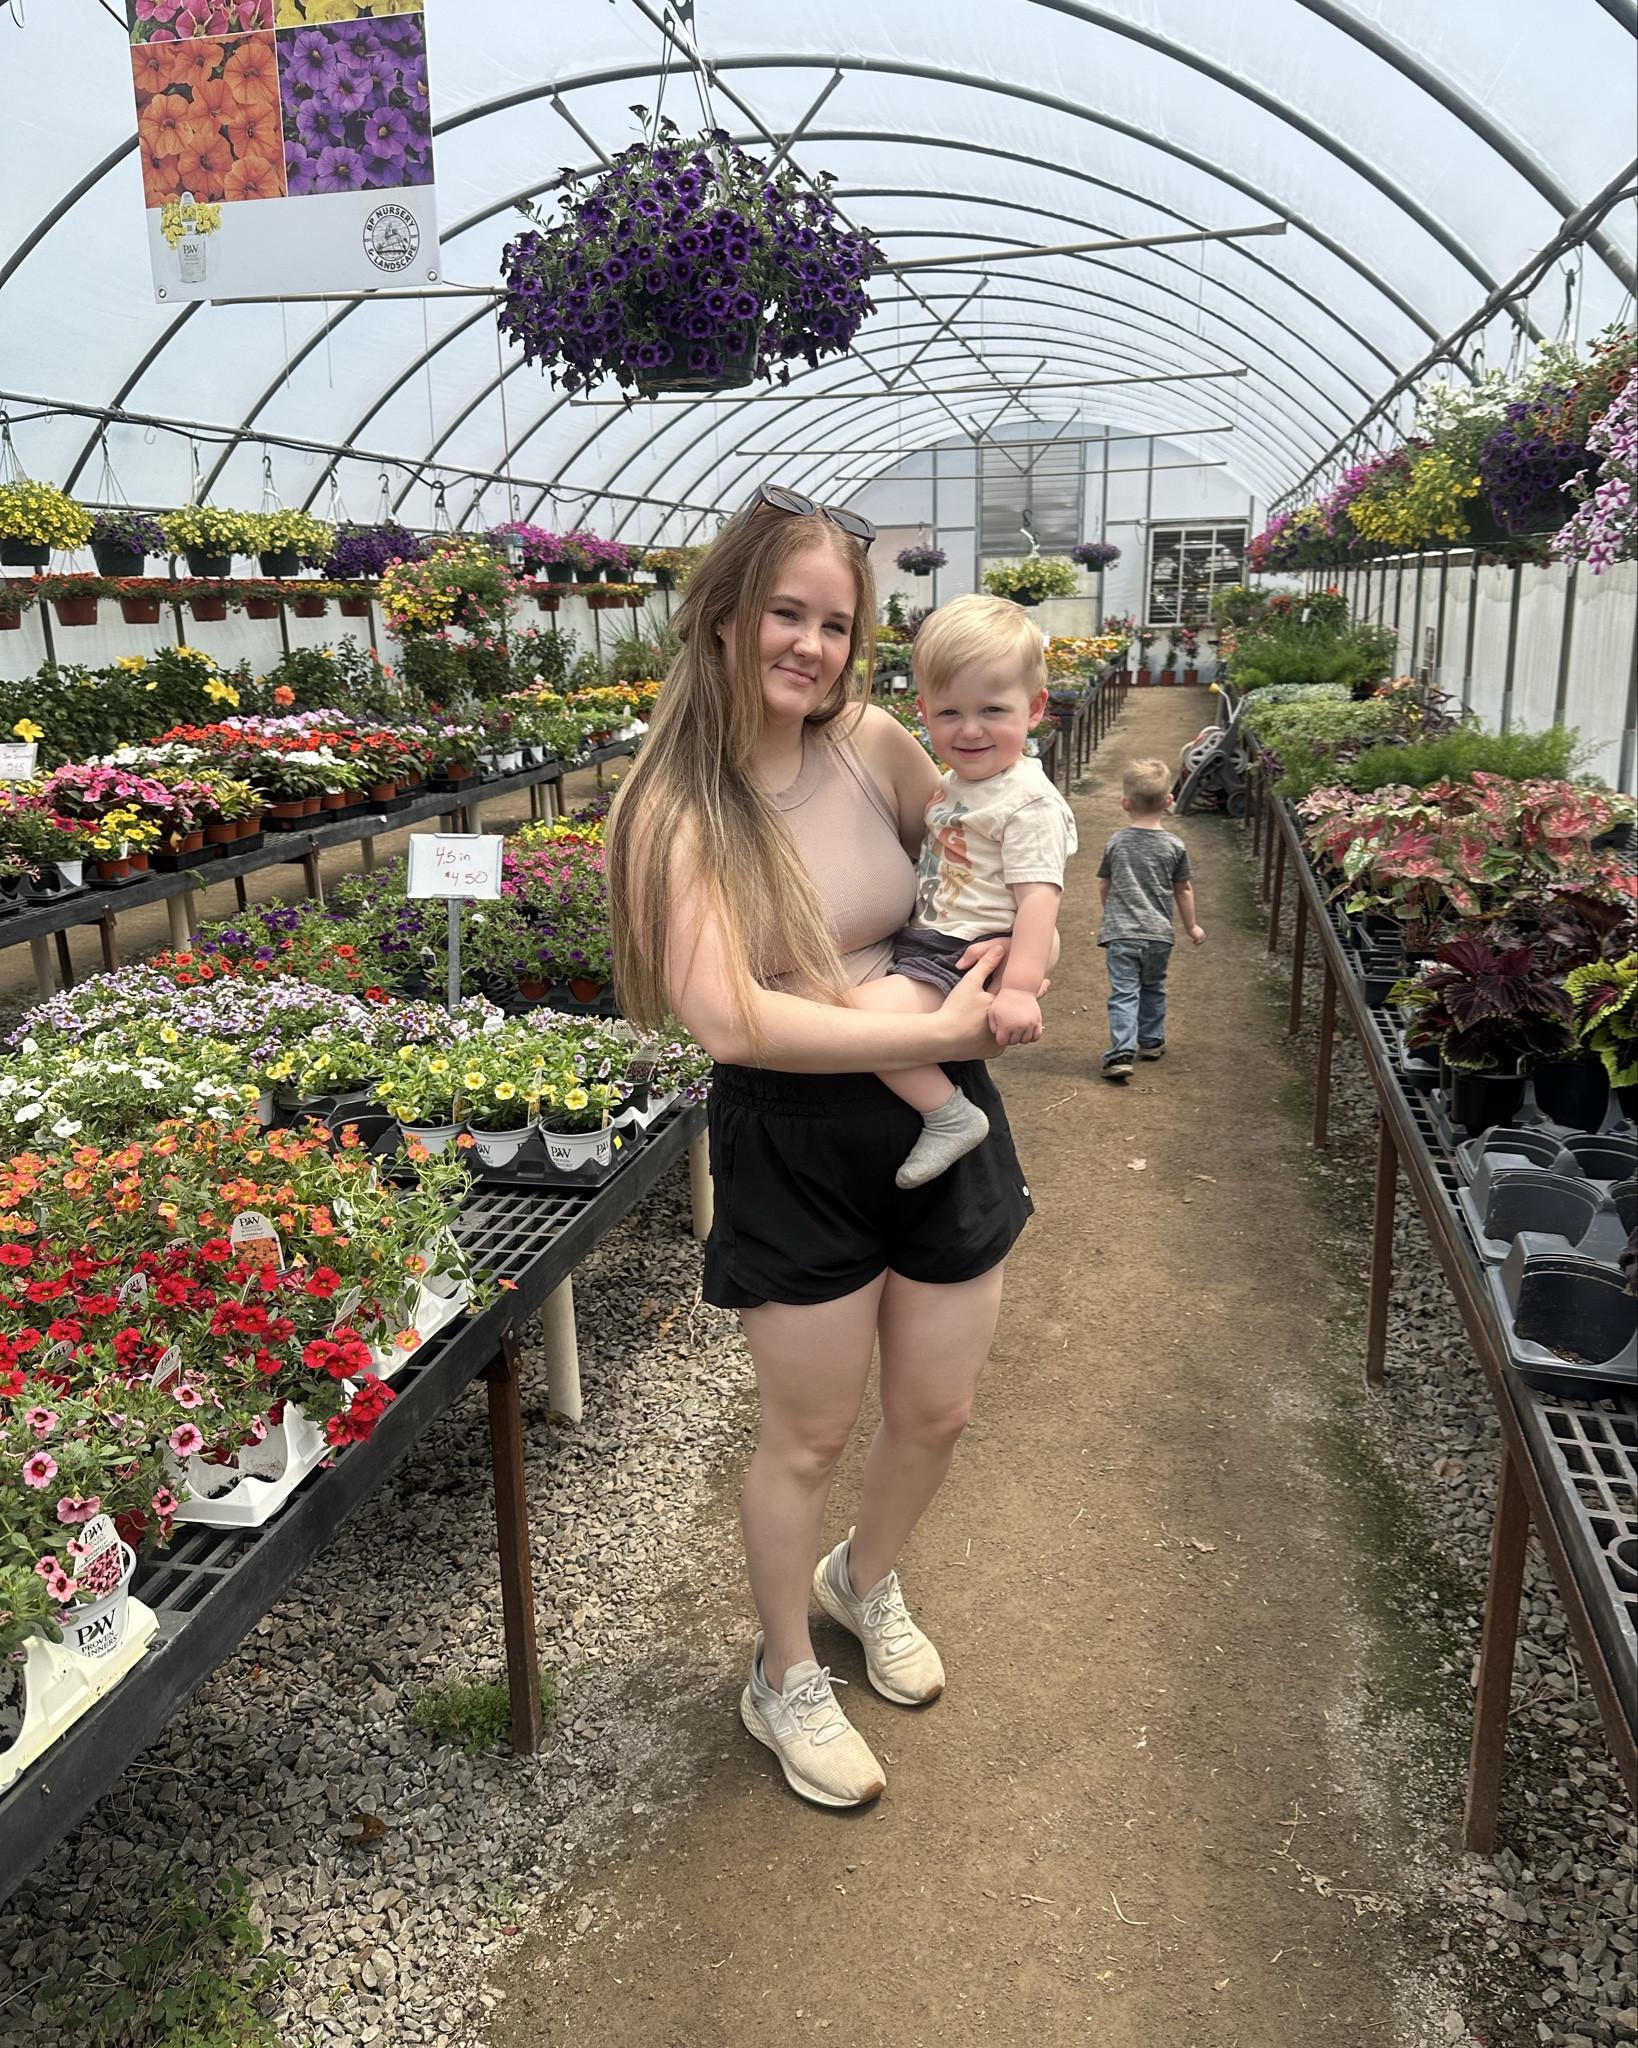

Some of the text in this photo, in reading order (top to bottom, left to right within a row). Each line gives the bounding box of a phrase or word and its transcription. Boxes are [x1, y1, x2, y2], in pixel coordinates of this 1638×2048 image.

[366, 206, 415, 232] BP NURSERY
[374, 244, 416, 270] LANDSCAPE
[551, 1146, 572, 1158] PW
[239, 1216, 260, 1226] PW
[84, 1518, 106, 1544] PW
[75, 1608, 116, 1647] PW
[82, 1630, 114, 1652] PROVEN
